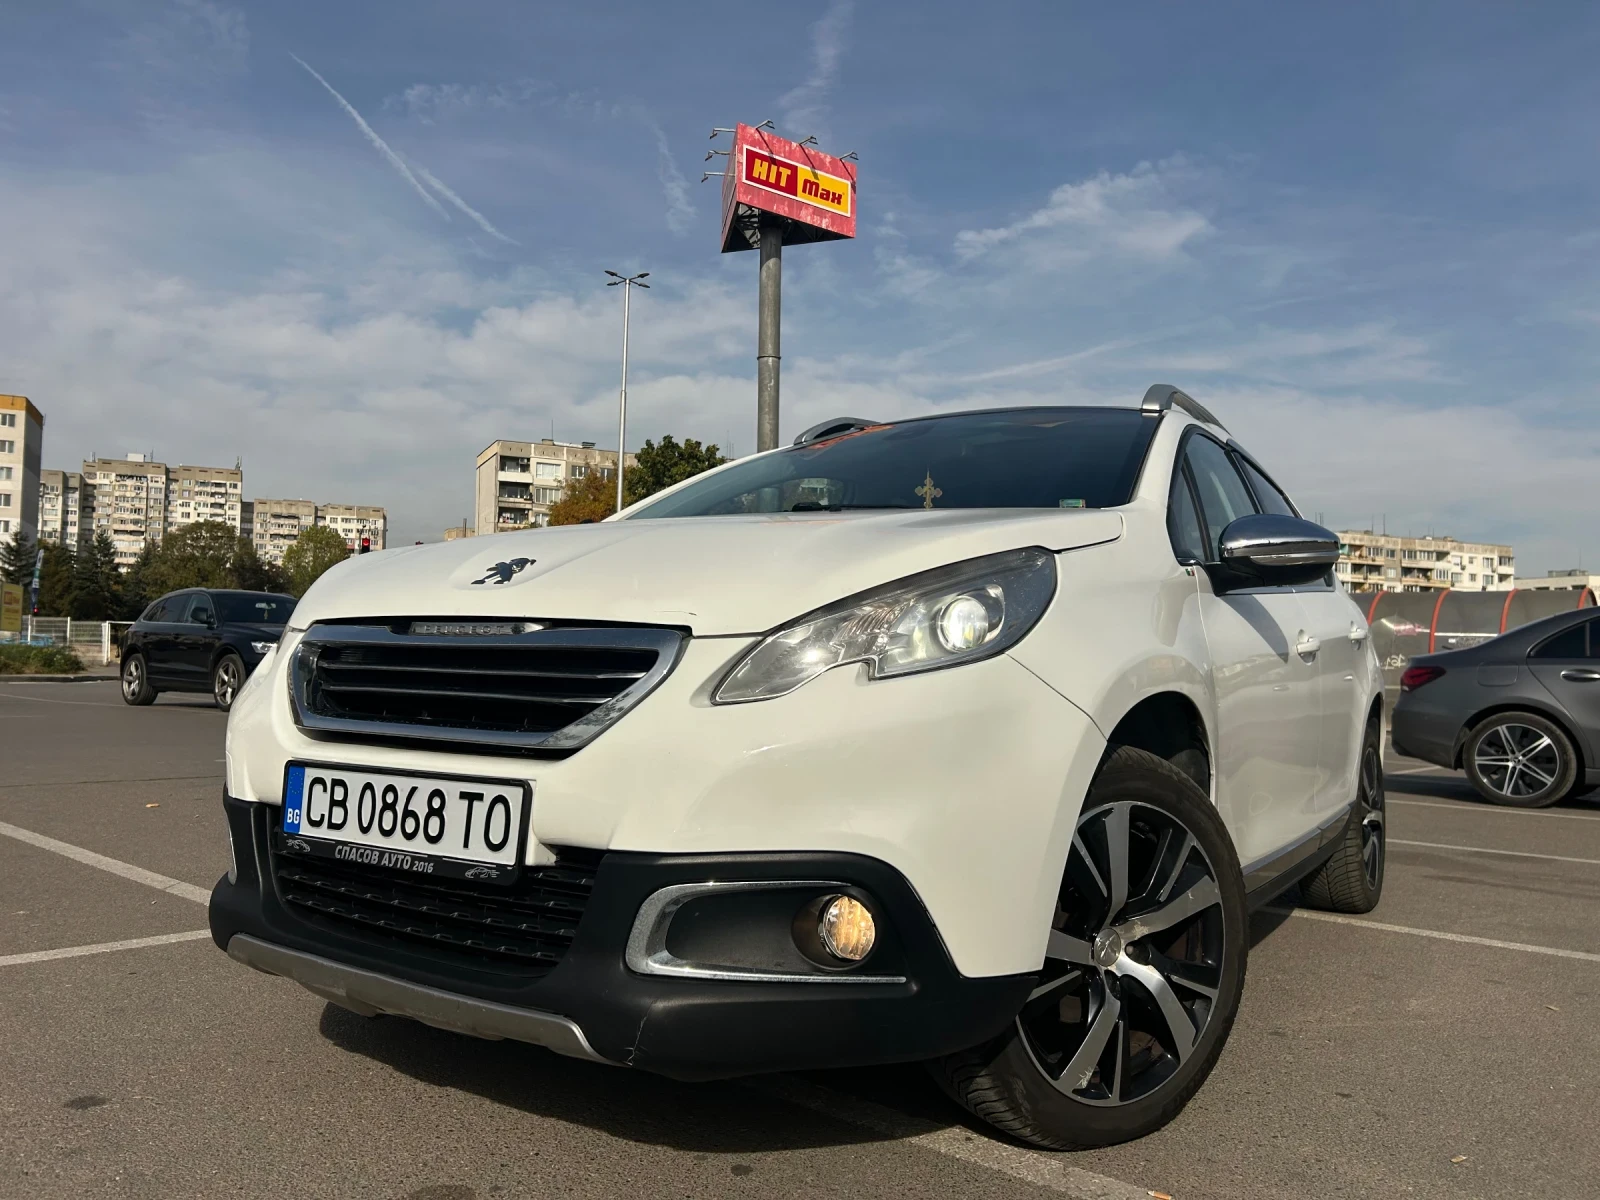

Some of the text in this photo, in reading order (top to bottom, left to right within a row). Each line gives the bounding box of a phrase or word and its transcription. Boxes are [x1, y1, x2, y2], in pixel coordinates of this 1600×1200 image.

[752, 158, 791, 187] HIT
[286, 807, 300, 825] BG
[306, 776, 512, 853] CB 0868 TO
[334, 845, 434, 873] СПАСОВ АУТО 2016
